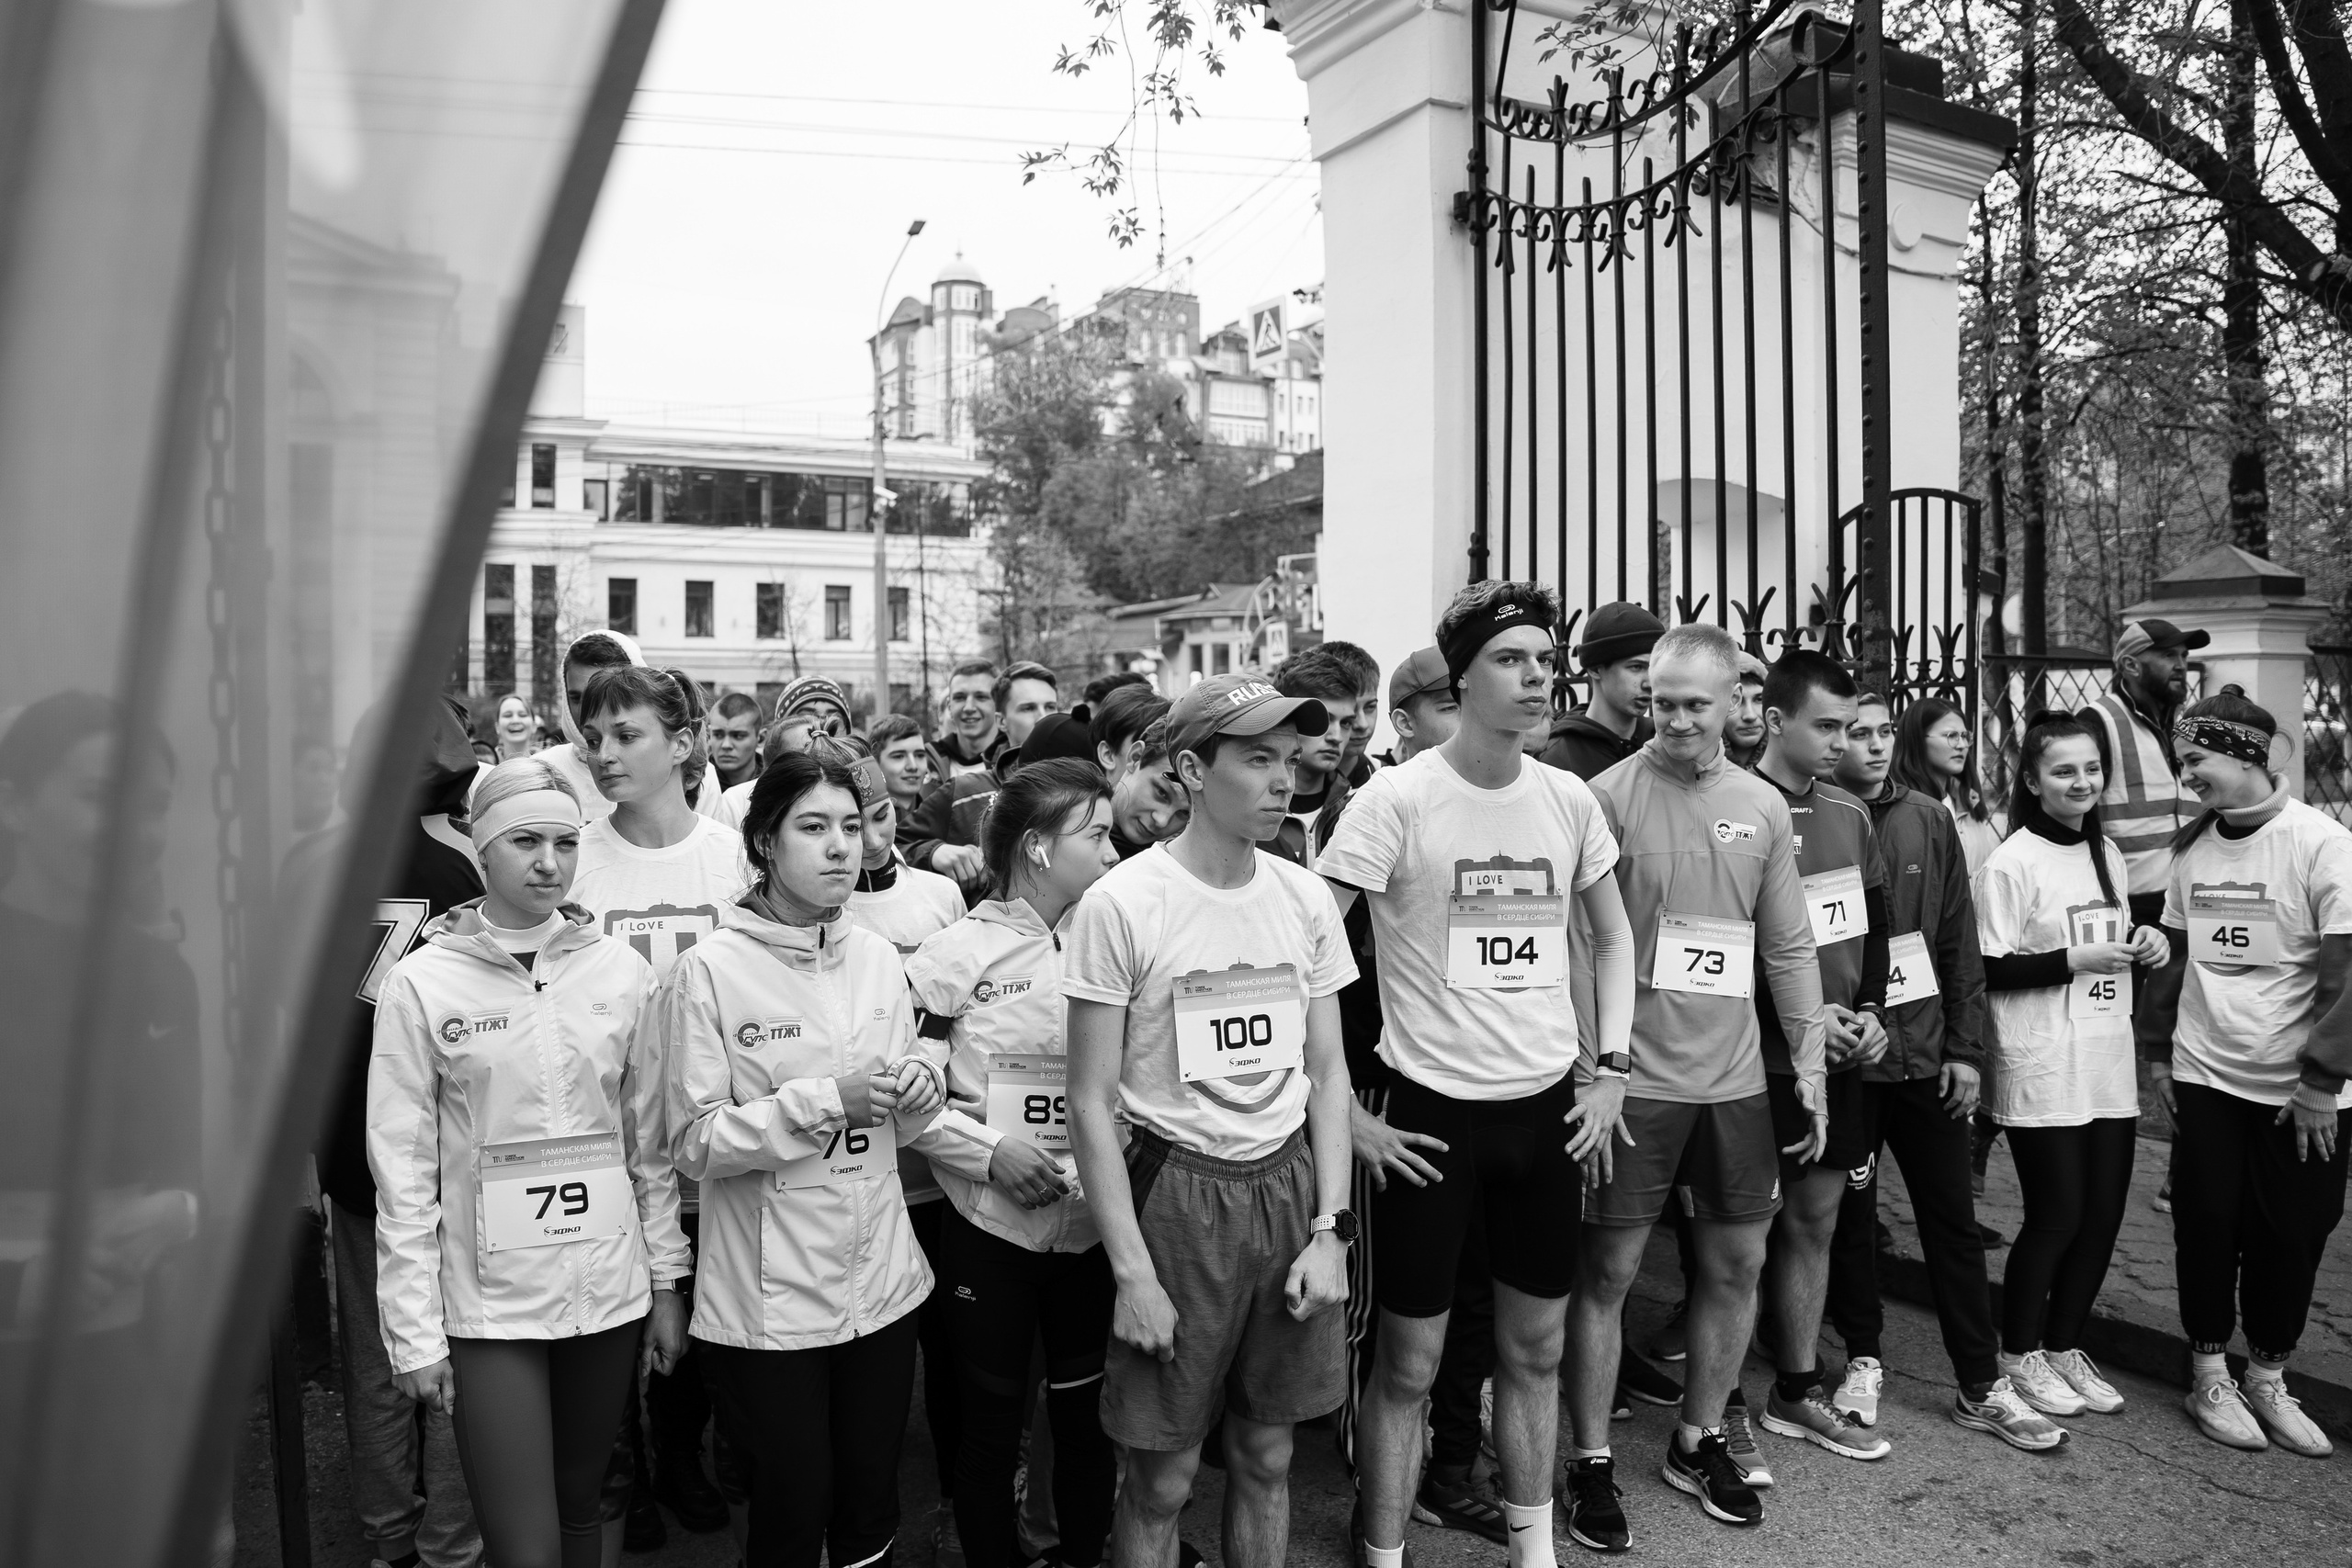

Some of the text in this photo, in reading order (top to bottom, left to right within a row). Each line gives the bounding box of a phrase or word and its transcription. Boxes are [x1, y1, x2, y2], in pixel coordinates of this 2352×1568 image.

[1736, 830, 1754, 840] ТТЖТ
[1469, 874, 1503, 886] I LOVE
[1822, 900, 1847, 925] 71
[629, 921, 663, 931] LOVE
[1698, 921, 1732, 931] ТАМАНСКАЯ
[1732, 925, 1748, 933] МИЛЯ
[2211, 925, 2250, 948] 46
[1476, 936, 1539, 965] 104
[1683, 947, 1725, 976] 73
[1226, 975, 1292, 988] ТАМАНСКАЯ МИЛЯ
[1888, 965, 1907, 986] 4
[1002, 982, 1032, 995] ТТЖТ
[1232, 990, 1261, 999] СЕРДЦЕ
[1261, 987, 1291, 995] СИБИРИ
[2088, 980, 2116, 1001] 45
[474, 1019, 509, 1033] ТТЖТ
[1209, 1013, 1272, 1052] 100
[770, 1027, 801, 1040] ТТЖТ
[540, 1142, 612, 1156] ТАМАНСКАЯ МИЛЯ
[548, 1157, 581, 1168] СЕРДЦЕ
[582, 1153, 612, 1163] СИБИРИ
[526, 1181, 590, 1221] 79
[550, 1225, 582, 1235] ЭФКО
